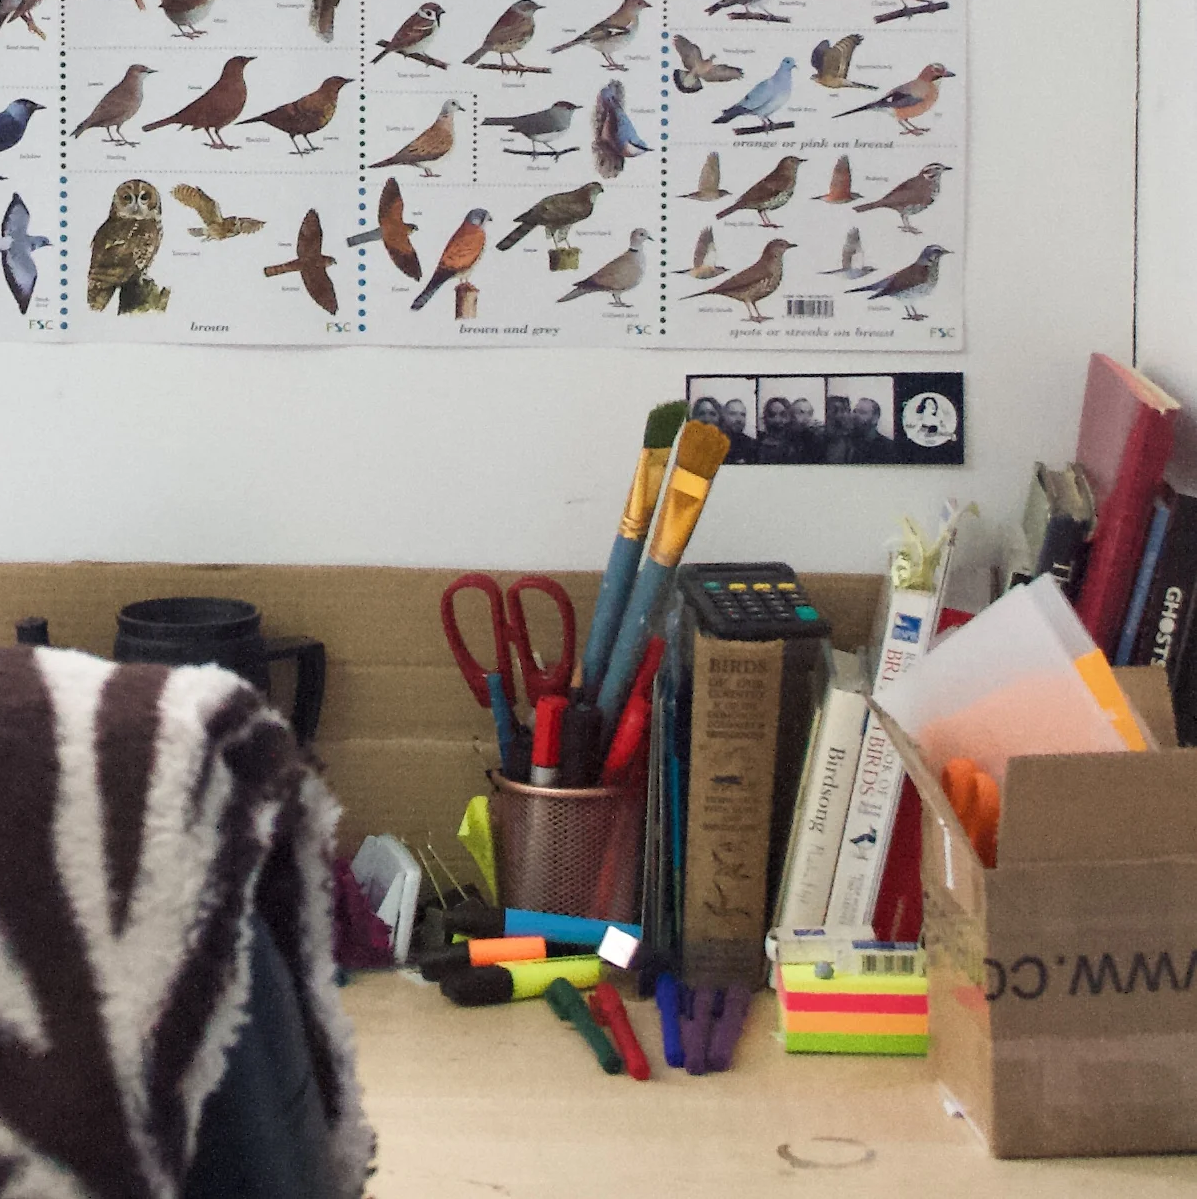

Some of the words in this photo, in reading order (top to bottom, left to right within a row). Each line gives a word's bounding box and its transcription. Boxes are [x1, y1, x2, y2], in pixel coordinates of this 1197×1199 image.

[733, 140, 778, 150] orange
[782, 140, 796, 149] or
[800, 138, 828, 151] pink
[832, 140, 850, 149] on
[853, 139, 895, 149] breast
[29, 320, 54, 330] FSC
[190, 322, 229, 332] brown
[326, 322, 351, 333] FSC
[459, 324, 498, 335] brown
[503, 324, 528, 335] and
[531, 325, 560, 337] grey
[626, 324, 652, 335] FSC
[766, 329, 780, 337] or
[833, 329, 850, 337] on
[854, 327, 895, 338] breast
[930, 327, 955, 338] FSC
[859, 735, 886, 796] BIRDS
[808, 746, 846, 833] Birdsong
